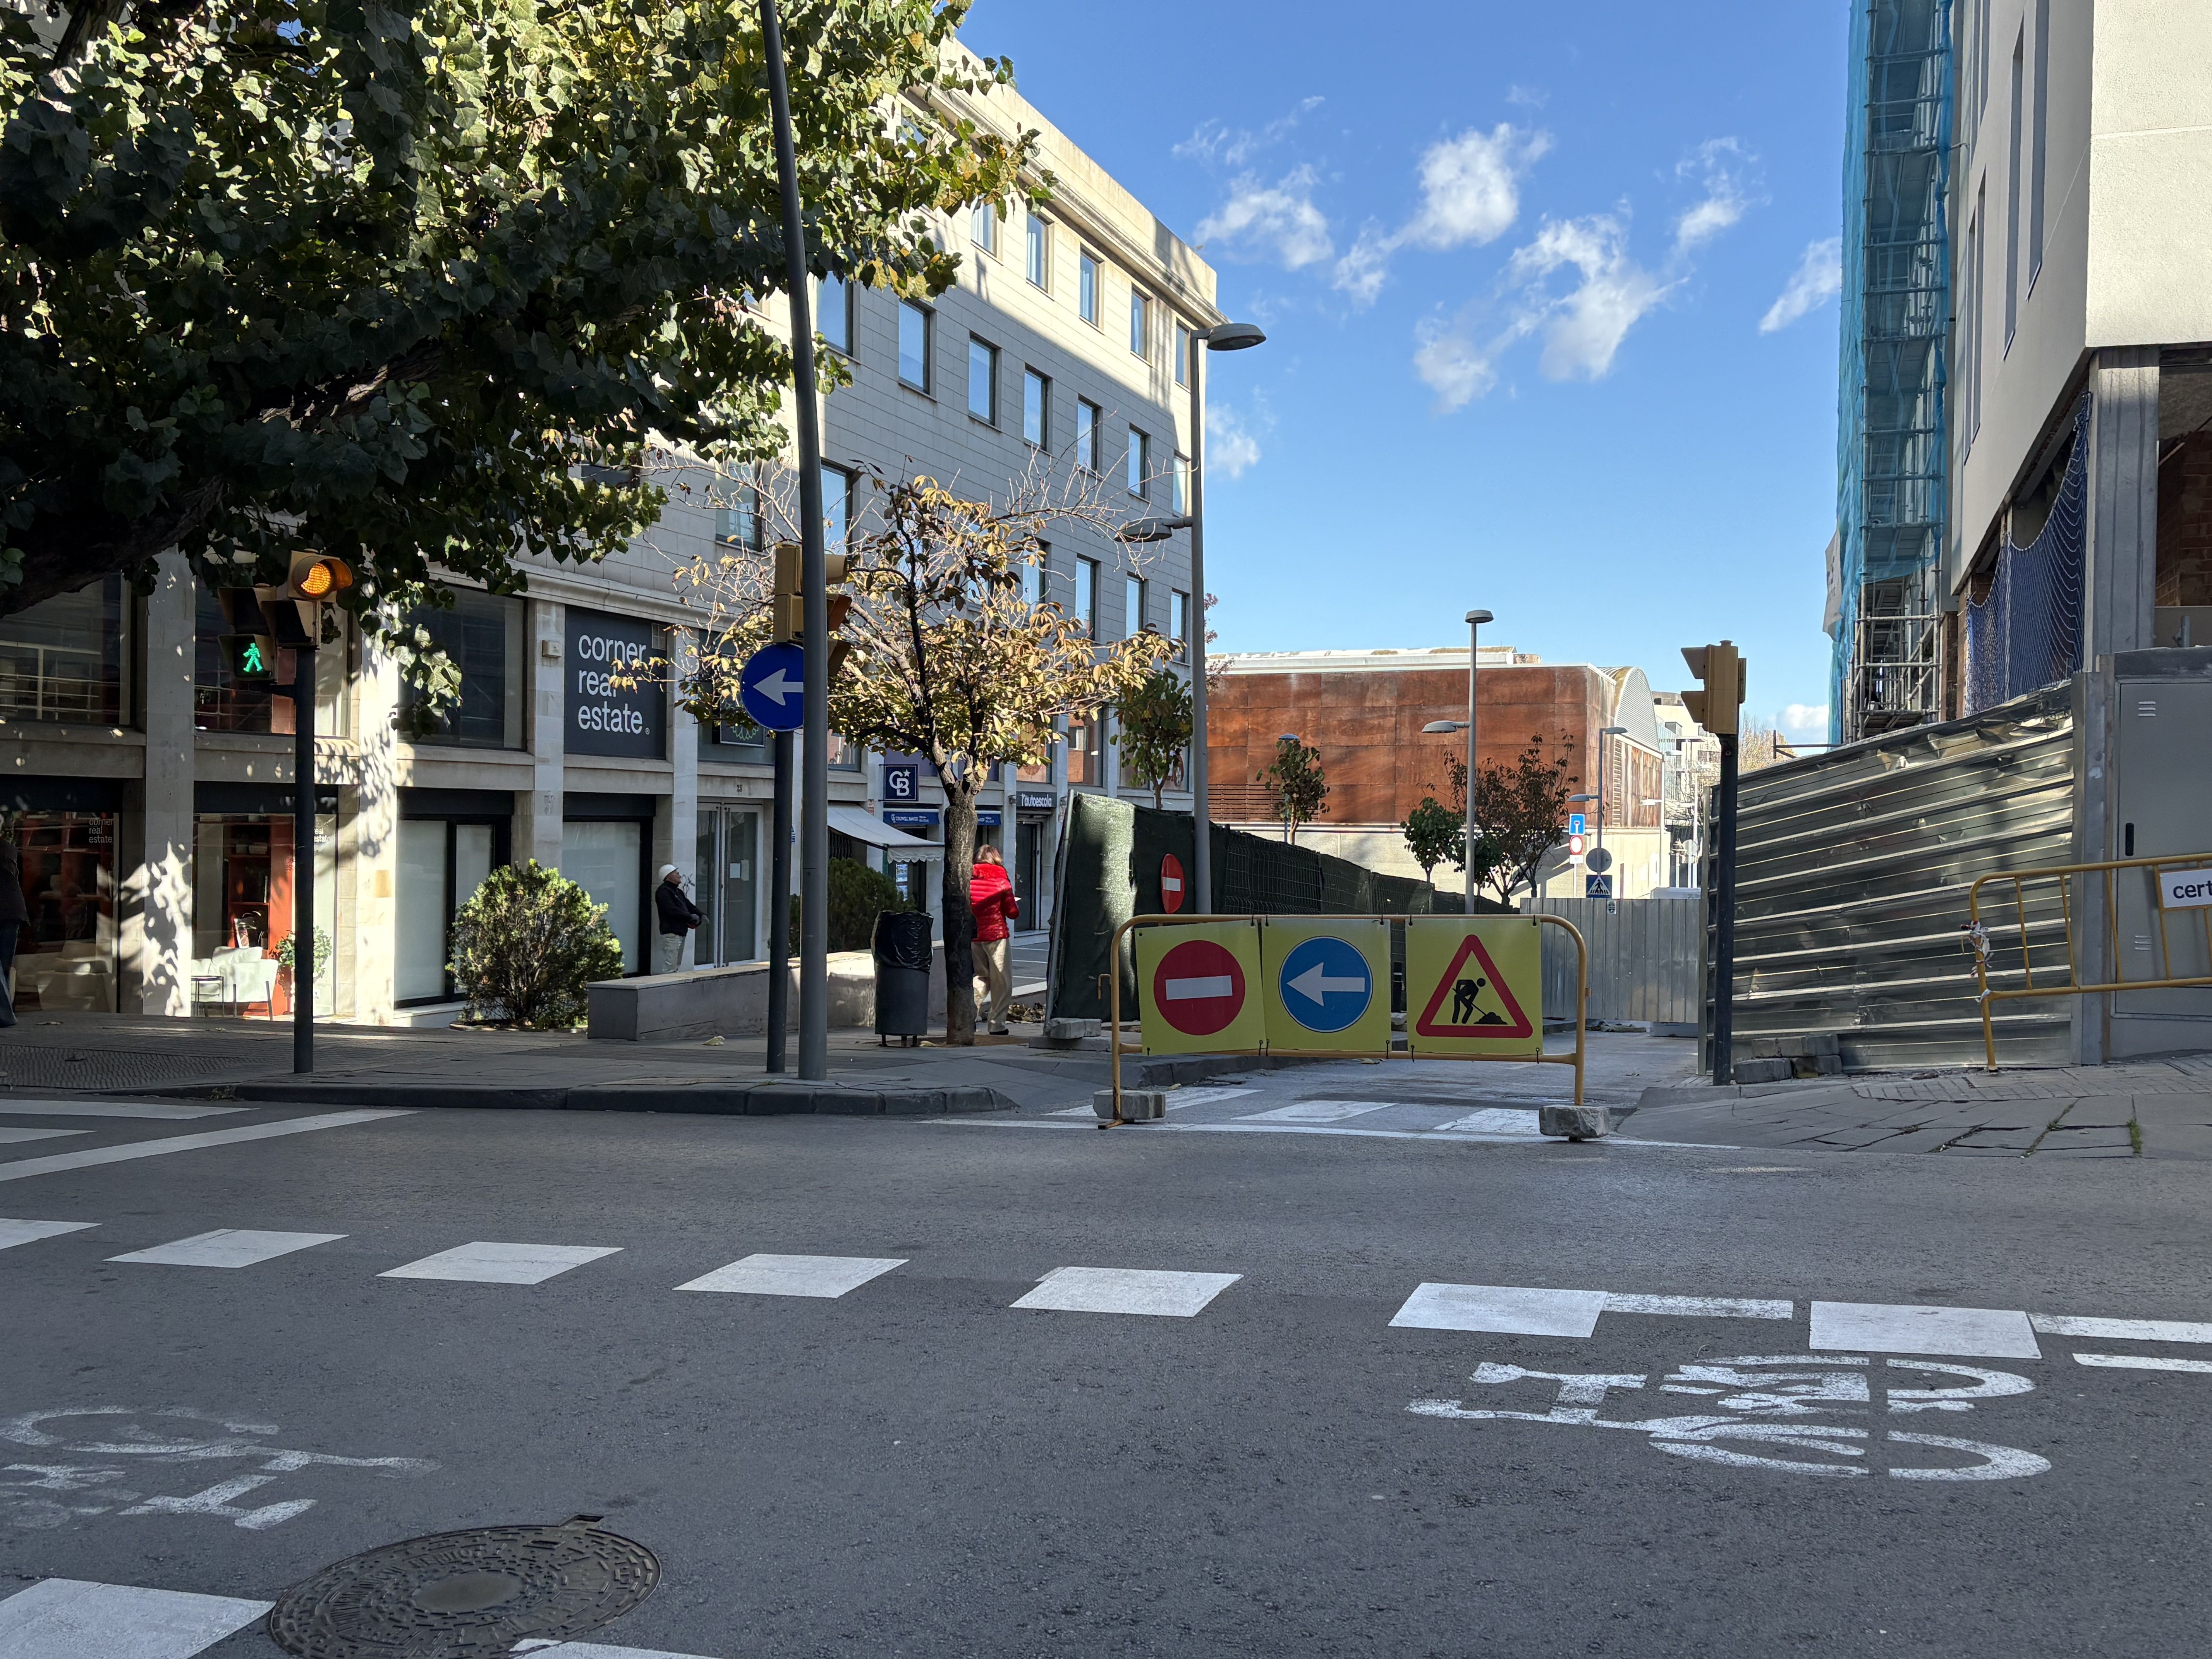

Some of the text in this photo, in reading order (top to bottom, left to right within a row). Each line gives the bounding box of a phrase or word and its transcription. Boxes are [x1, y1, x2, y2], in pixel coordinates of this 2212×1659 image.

[579, 635, 646, 665] corner
[89, 825, 102, 834] real
[89, 835, 112, 843] estate
